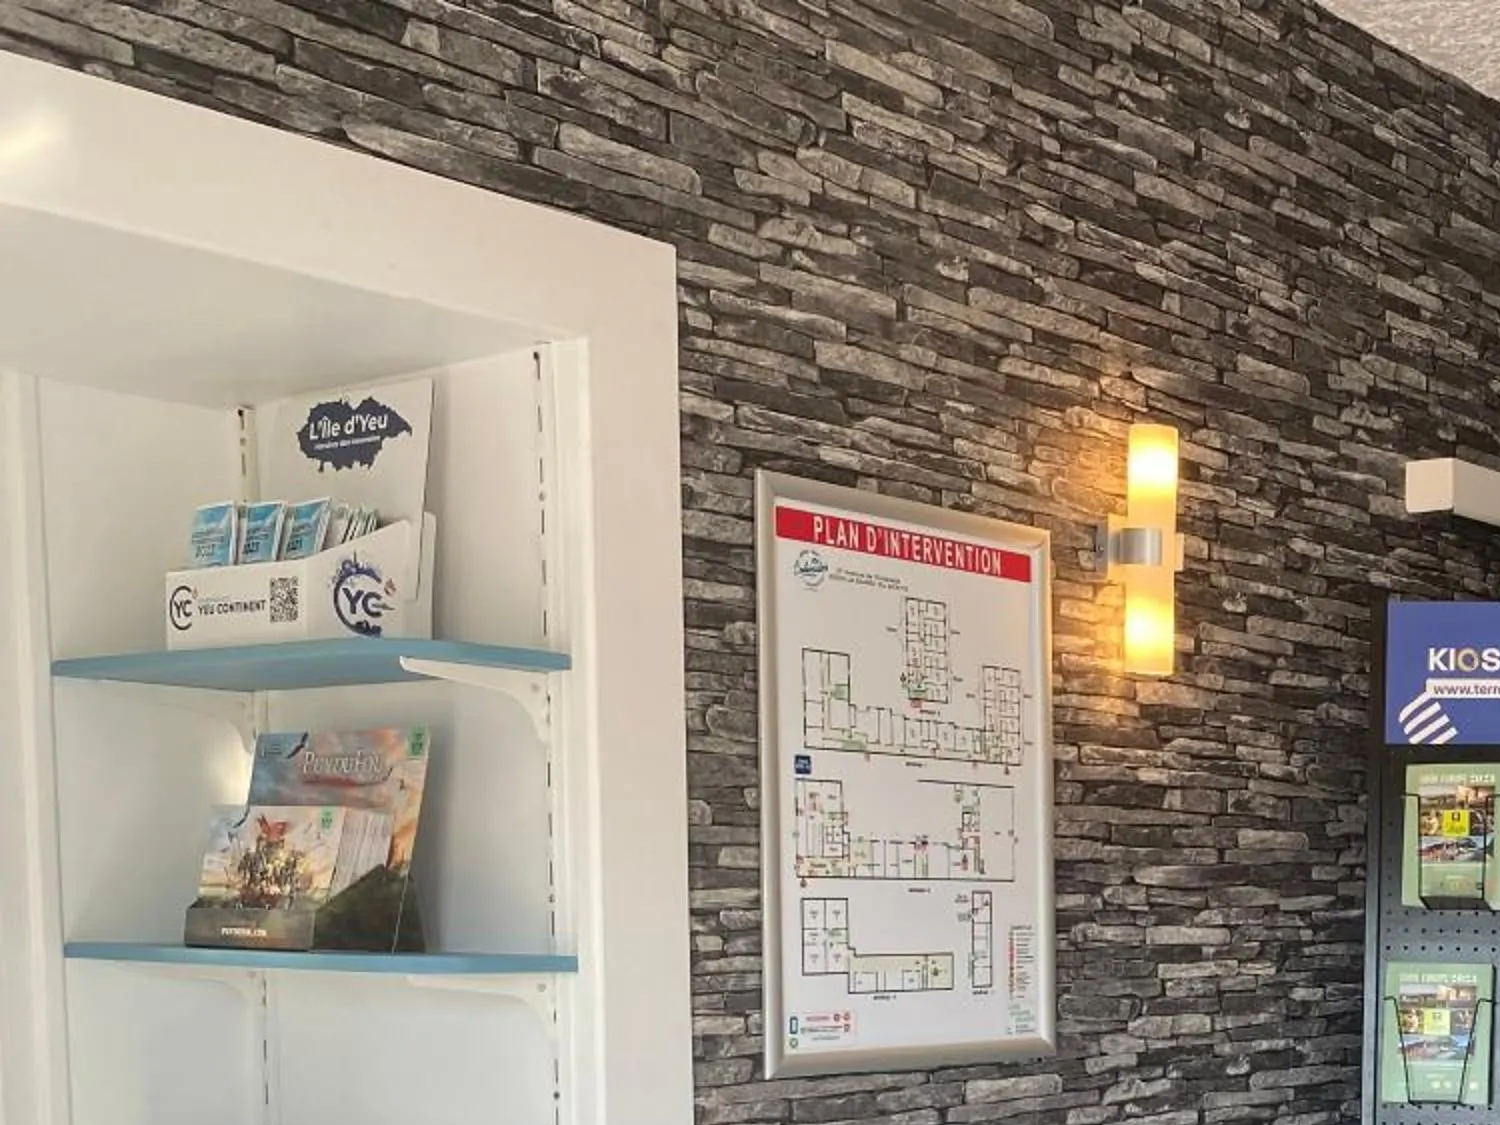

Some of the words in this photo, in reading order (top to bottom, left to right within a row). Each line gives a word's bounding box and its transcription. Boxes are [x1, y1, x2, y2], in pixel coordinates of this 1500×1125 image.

[344, 413, 388, 435] d'Yeu
[813, 515, 859, 549] PLAN
[866, 526, 1001, 575] D'INTERVENTION
